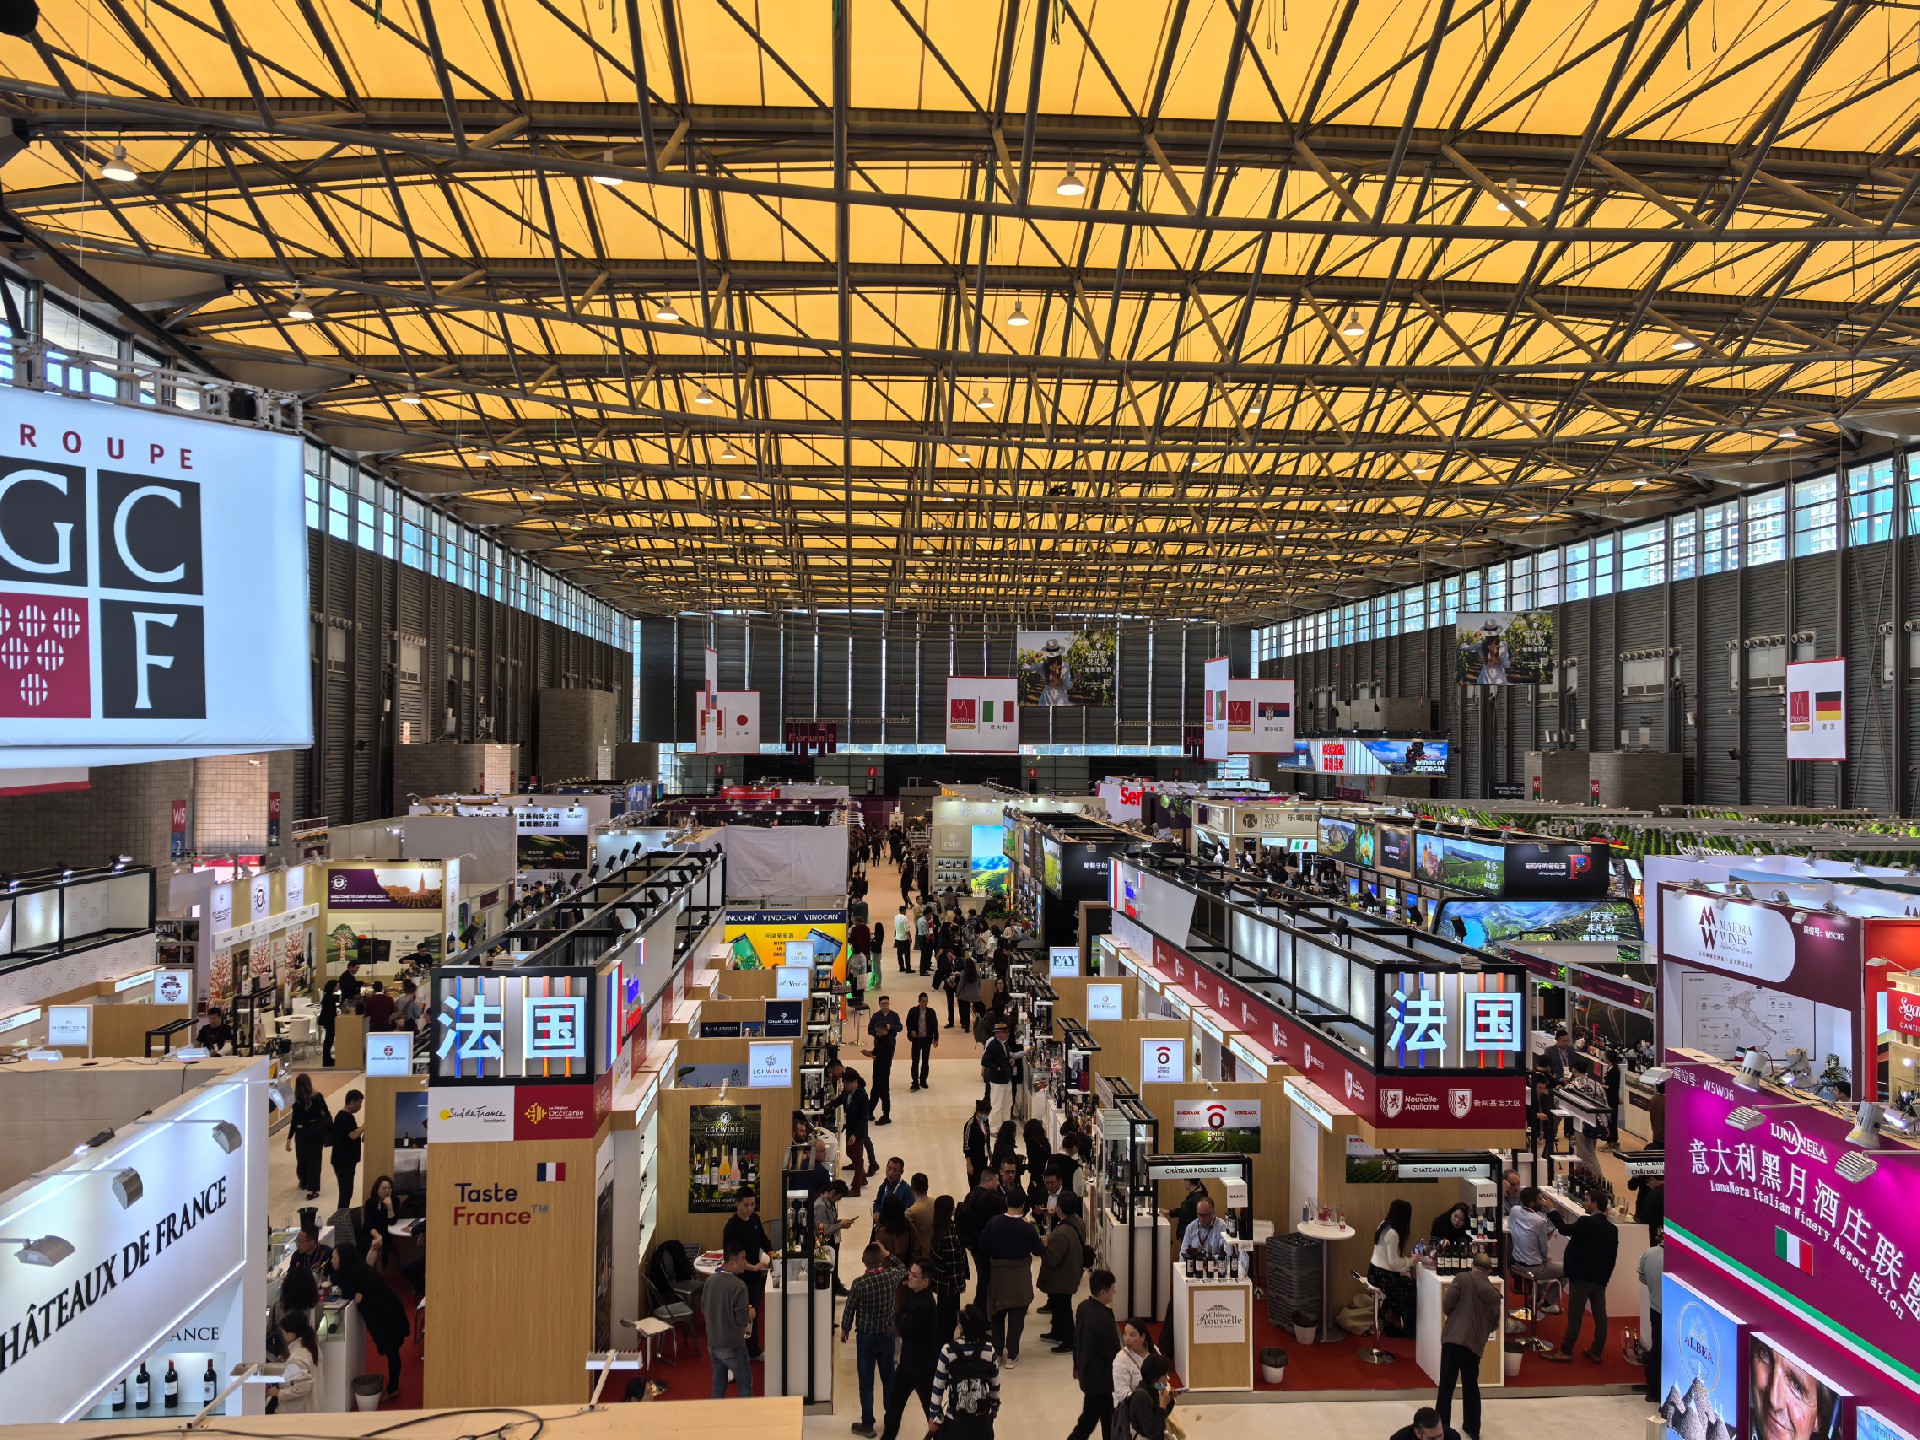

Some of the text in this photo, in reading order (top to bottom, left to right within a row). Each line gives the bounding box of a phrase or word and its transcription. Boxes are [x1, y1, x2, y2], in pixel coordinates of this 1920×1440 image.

[113, 485, 185, 583] C
[131, 611, 179, 709] F
[789, 733, 834, 742] Forum 2
[173, 807, 186, 825] W5
[804, 913, 839, 921] VINOCAN
[1588, 911, 1614, 923] 探索
[1585, 924, 1616, 934] 非凡的
[1898, 996, 1920, 1021] Sga
[436, 995, 585, 1060] 法国
[1386, 989, 1522, 1052] 法国
[548, 1109, 584, 1118] Occitanie
[1405, 1103, 1440, 1111] Aquitaine
[1165, 1166, 1193, 1174] CHÂTEAU
[454, 1183, 518, 1203] Taste
[453, 1206, 531, 1227] France
[122, 1230, 150, 1282] DE
[155, 1175, 227, 1256] FRANCE
[1688, 1138, 1920, 1321] 意大利黑月酒庄联盟
[1753, 1190, 1791, 1215] Italian
[1794, 1205, 1831, 1241] Winery
[1833, 1236, 1904, 1321] Association
[168, 1326, 220, 1342] ANCE
